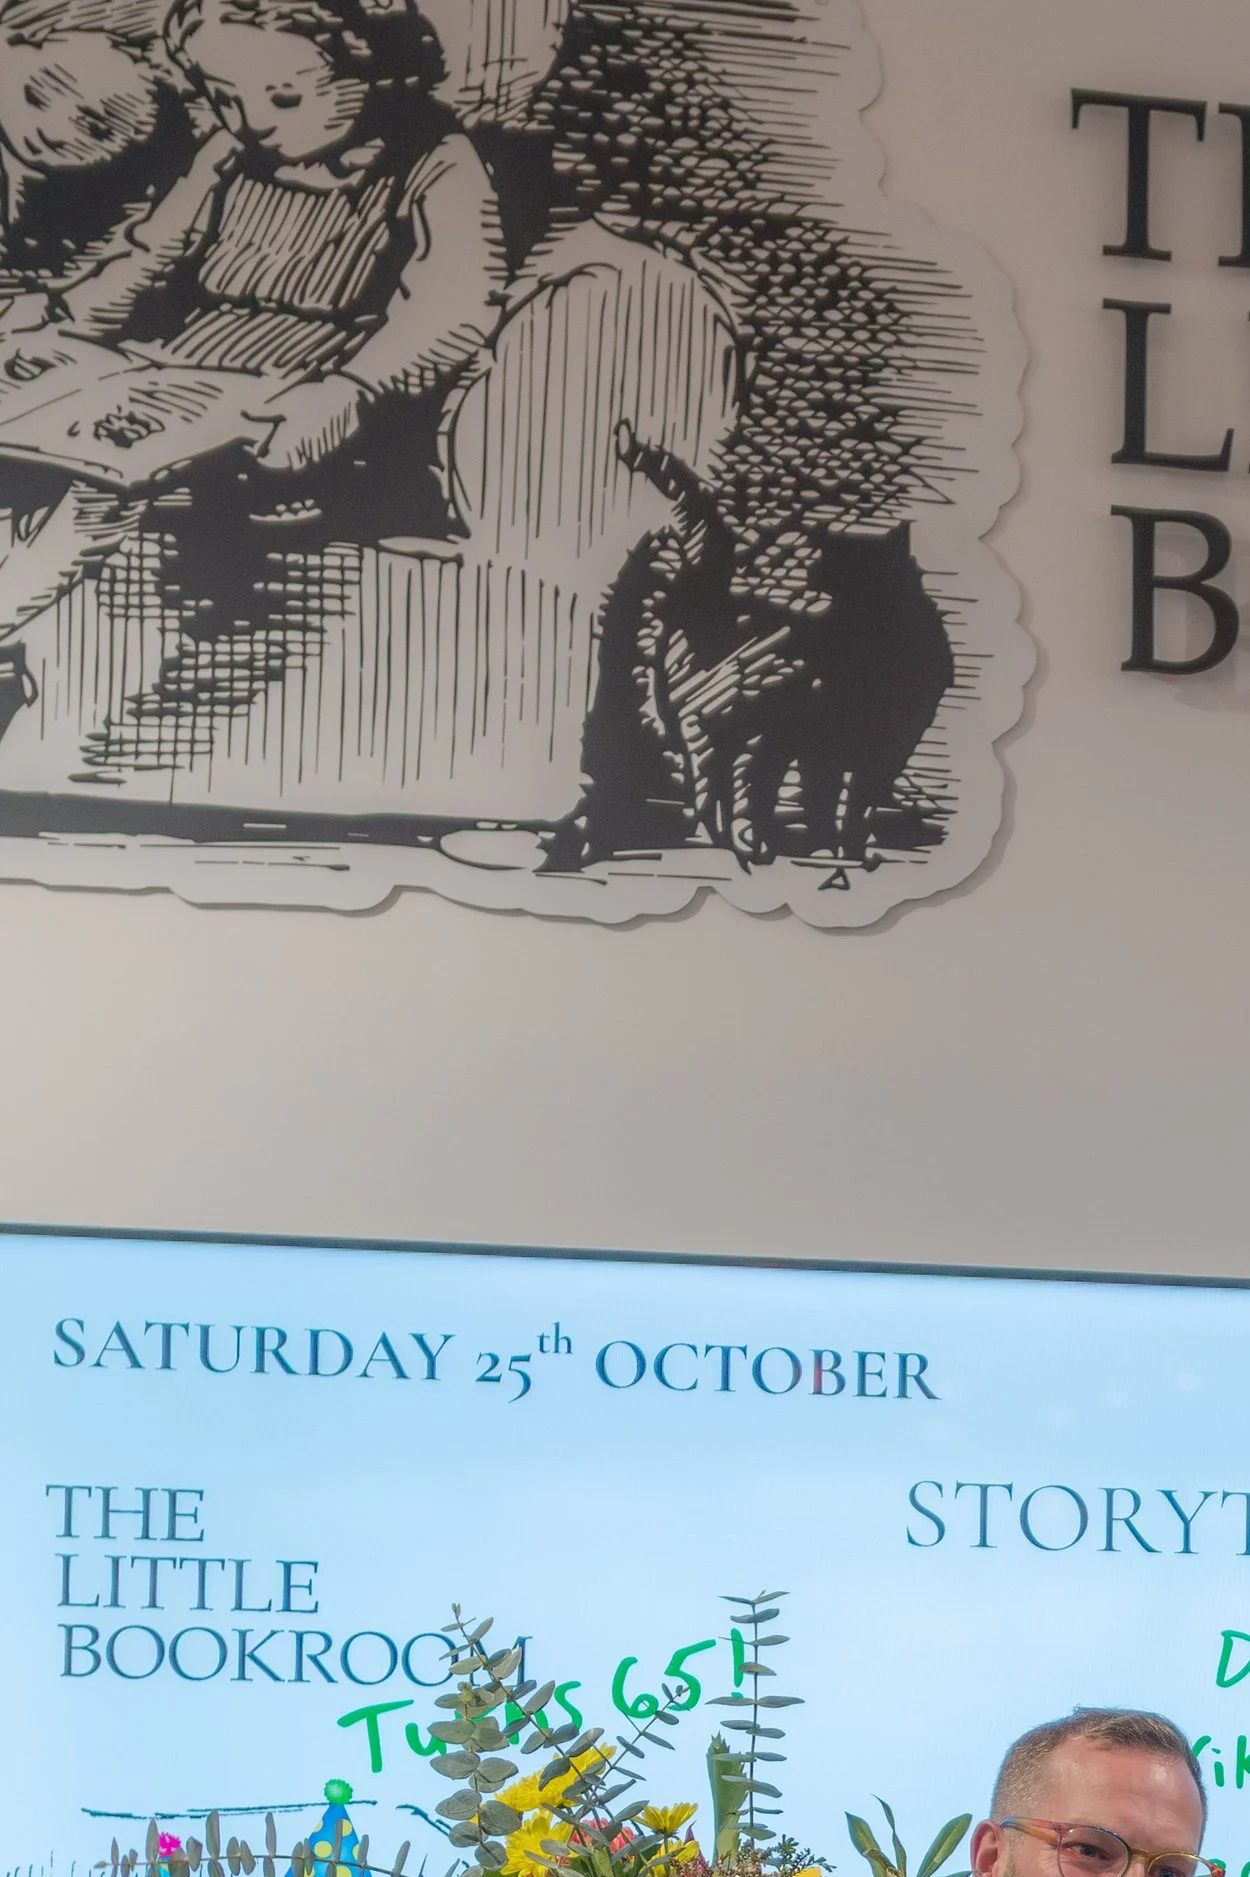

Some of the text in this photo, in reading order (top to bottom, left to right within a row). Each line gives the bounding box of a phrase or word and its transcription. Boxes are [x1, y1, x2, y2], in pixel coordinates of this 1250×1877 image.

[53, 1317, 942, 1404] SATURDAY 25th OCTOBER
[45, 1484, 205, 1543] THE
[55, 1553, 320, 1613] LITTLE
